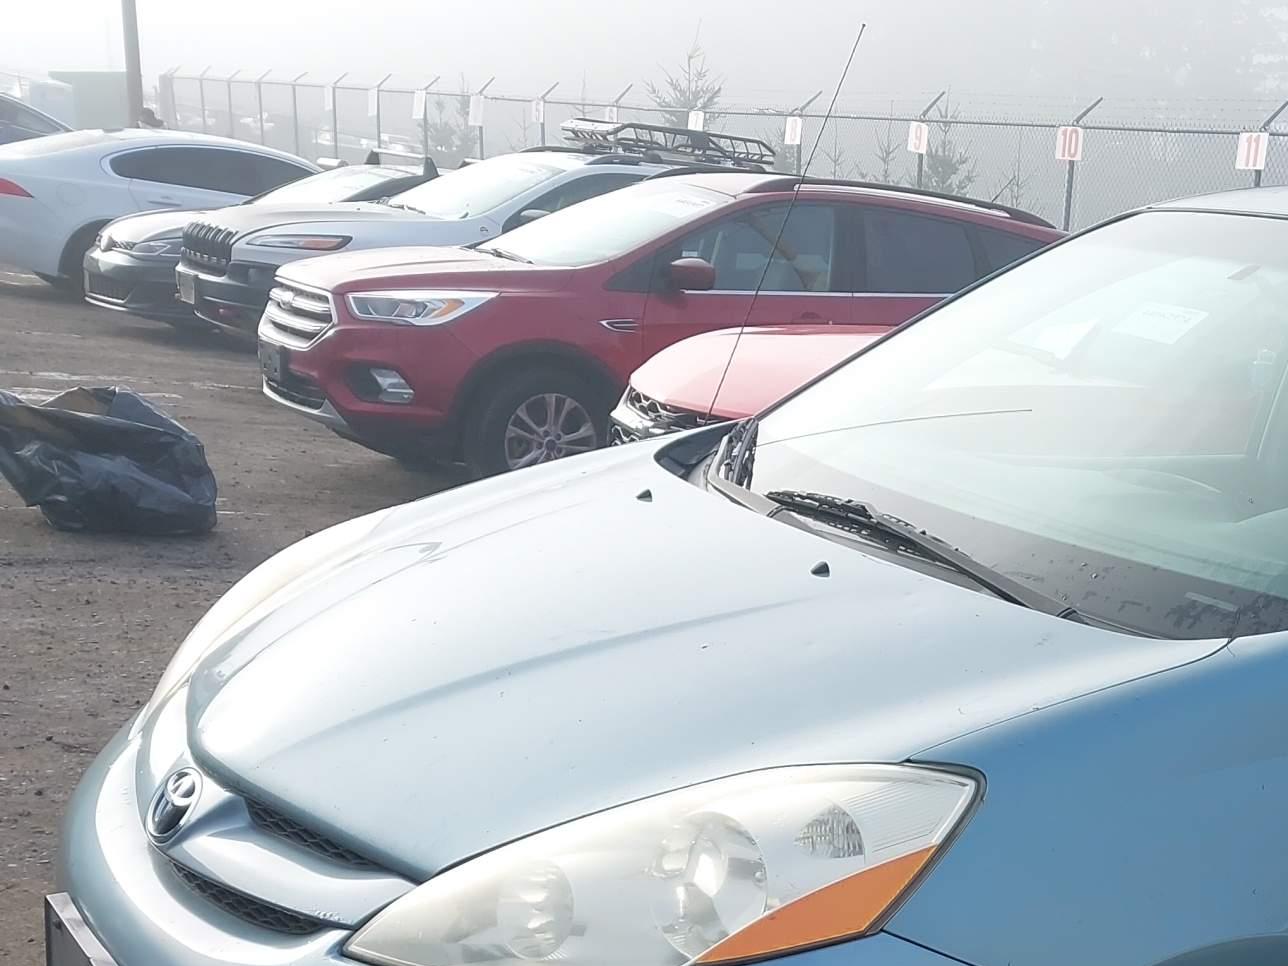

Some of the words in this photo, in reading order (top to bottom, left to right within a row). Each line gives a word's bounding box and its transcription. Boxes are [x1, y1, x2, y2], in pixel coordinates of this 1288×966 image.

[913, 123, 923, 150] 9
[1059, 127, 1080, 159] 10
[1244, 134, 1262, 167] 11
